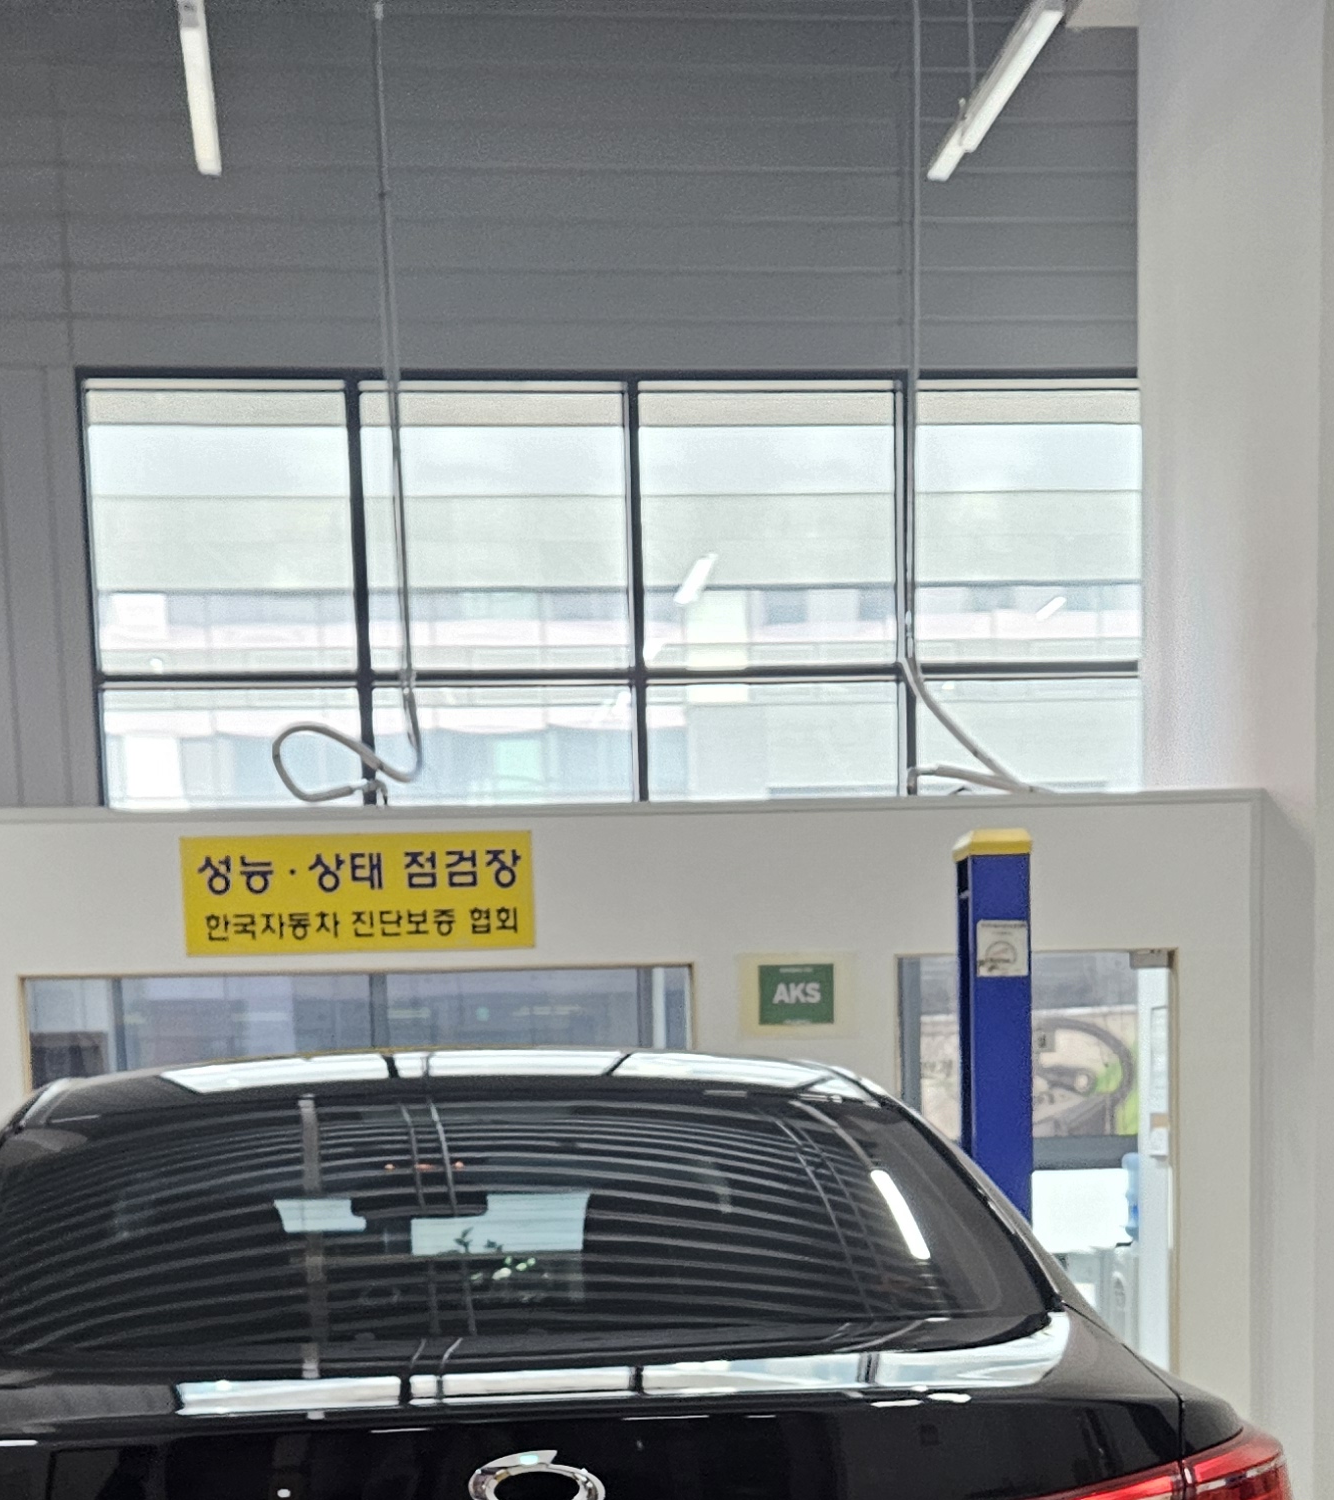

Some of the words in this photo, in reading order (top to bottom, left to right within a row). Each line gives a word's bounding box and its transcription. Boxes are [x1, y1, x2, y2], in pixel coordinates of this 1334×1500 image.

[403, 849, 522, 889] 점검장
[205, 910, 341, 942] 한국자동차
[351, 908, 457, 938] 진단보증
[469, 906, 520, 935] 협회
[772, 982, 822, 1005] AKS
